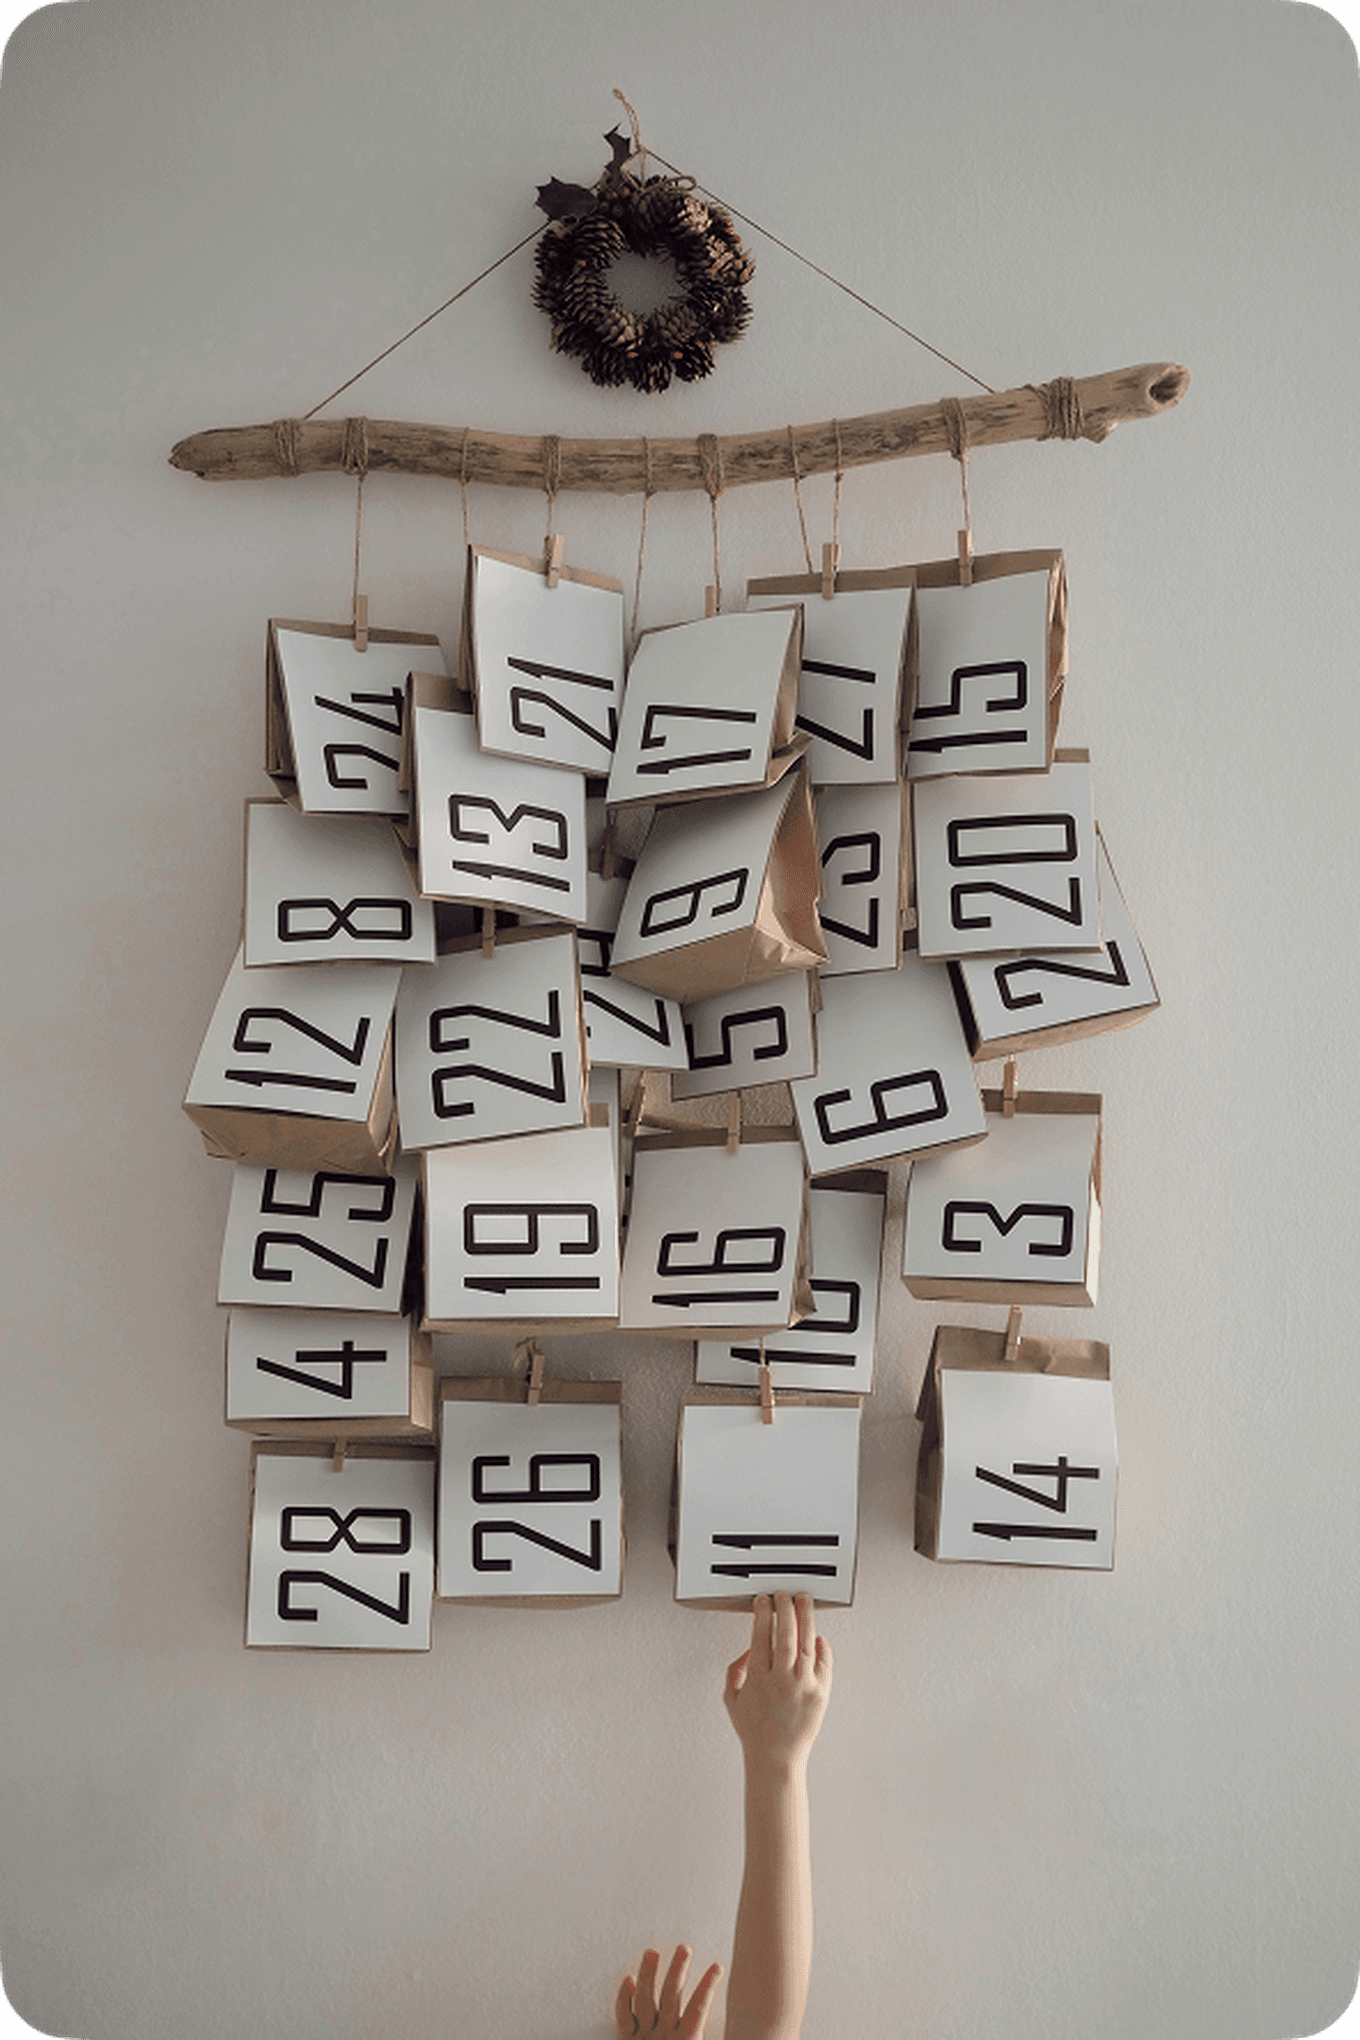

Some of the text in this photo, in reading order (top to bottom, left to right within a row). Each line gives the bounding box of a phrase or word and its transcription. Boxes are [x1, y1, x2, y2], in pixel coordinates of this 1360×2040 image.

[507, 657, 617, 753] 21
[636, 704, 757, 775] 17
[908, 659, 1028, 754] 15
[448, 794, 571, 892] 13
[946, 814, 1082, 930] 20
[278, 898, 413, 942] 8
[639, 867, 749, 938] 9
[994, 940, 1130, 1010] 2
[224, 1007, 371, 1094] 12
[429, 989, 566, 1119] 22
[684, 1005, 788, 1071] 5
[813, 1069, 949, 1145] 6
[252, 1168, 396, 1289] 25
[463, 1203, 600, 1295] 19
[651, 1227, 786, 1308] 16
[942, 1201, 1074, 1257] 3
[256, 1340, 387, 1400] 4
[472, 1453, 602, 1572] 26
[972, 1456, 1100, 1541] 14
[277, 1506, 412, 1625] 28
[711, 1534, 839, 1578] 11
